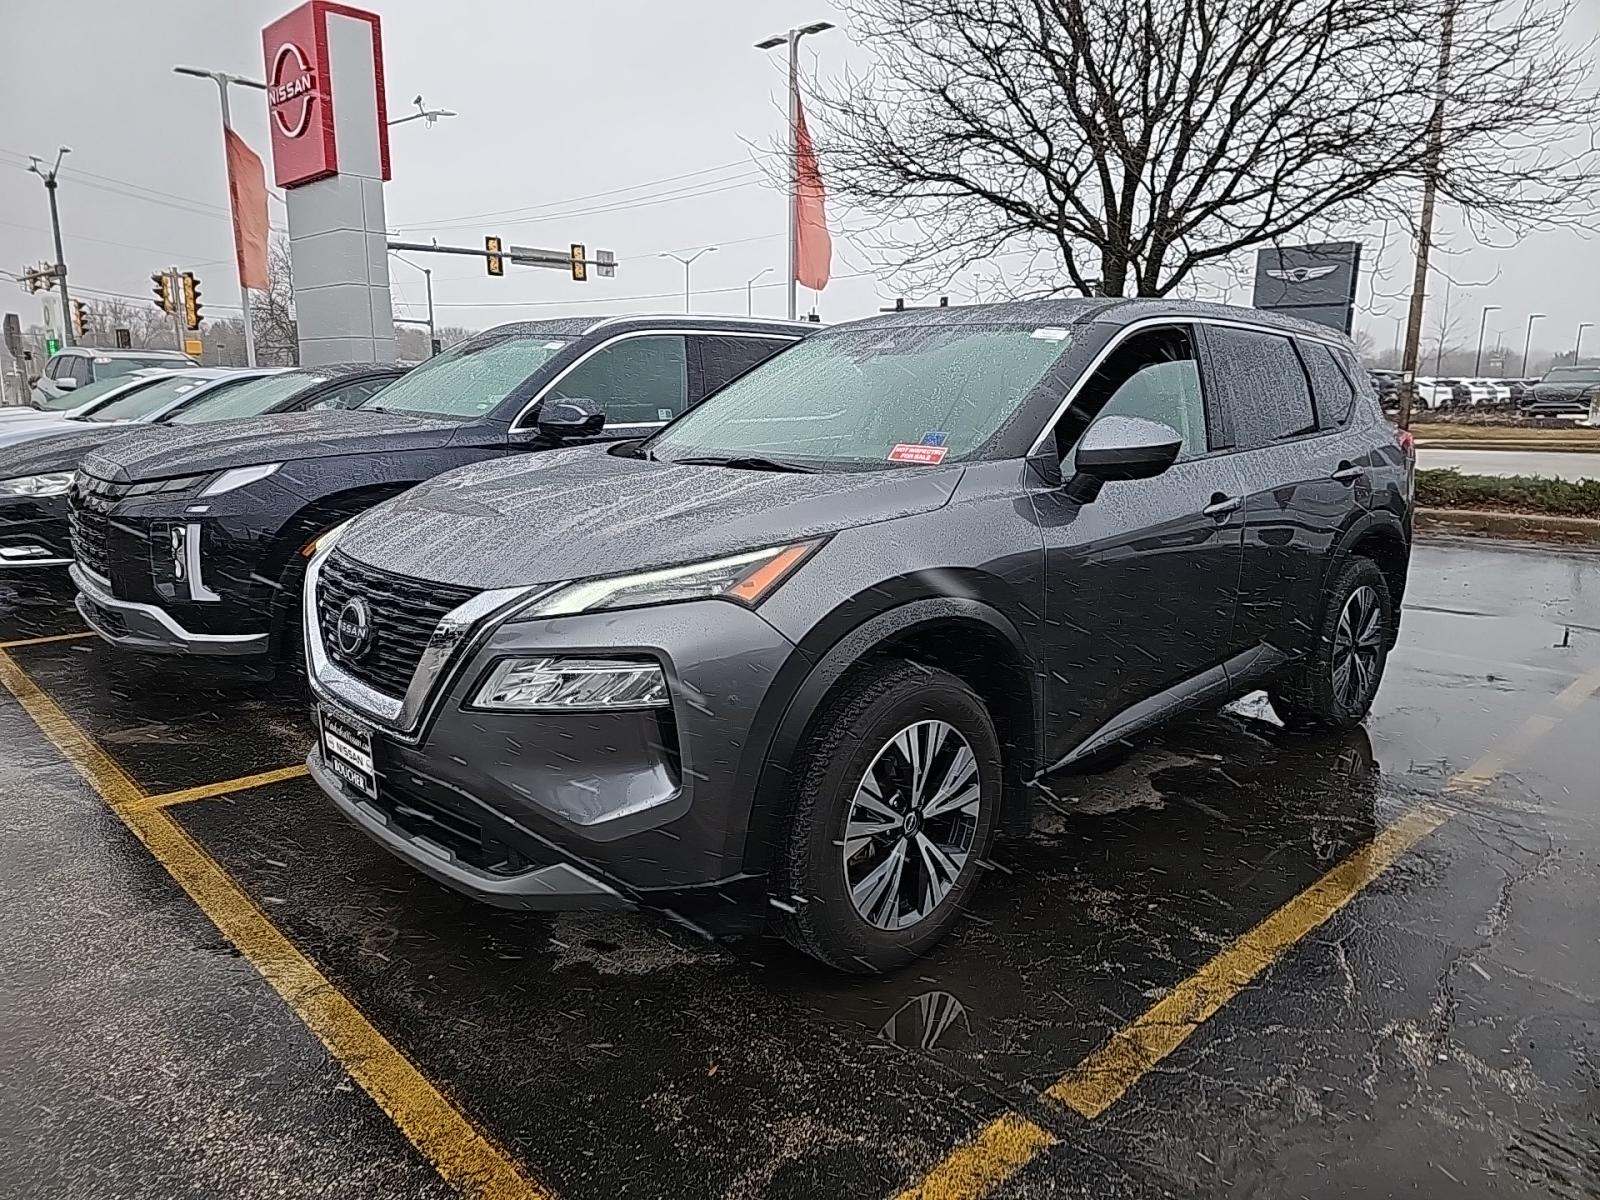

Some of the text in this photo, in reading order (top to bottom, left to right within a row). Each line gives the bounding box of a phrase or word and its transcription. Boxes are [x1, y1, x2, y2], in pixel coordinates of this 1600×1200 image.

[269, 73, 311, 105] NISSAN
[336, 741, 364, 766] NISSAN
[333, 759, 365, 790] BOUCHER
